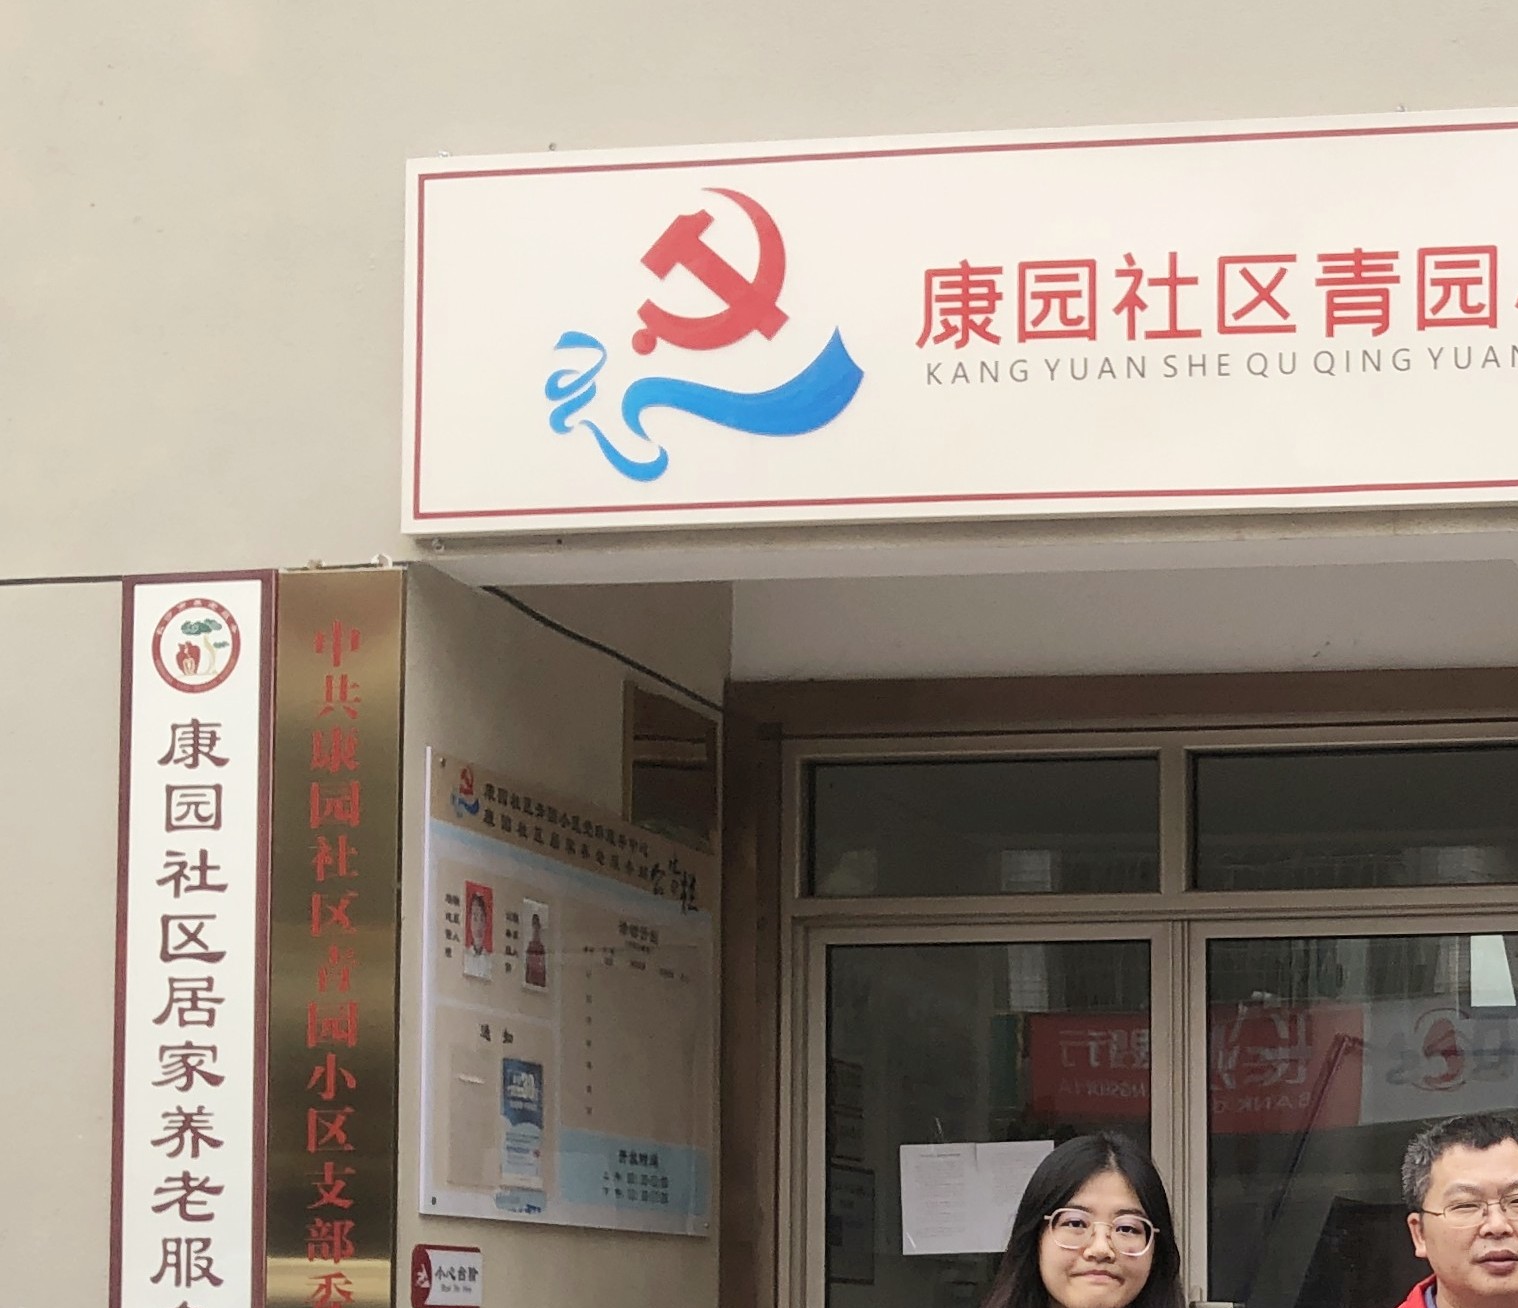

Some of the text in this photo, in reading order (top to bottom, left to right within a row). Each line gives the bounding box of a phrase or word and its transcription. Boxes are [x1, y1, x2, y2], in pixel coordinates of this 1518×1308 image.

[928, 360, 1027, 384] KANG
[1045, 356, 1145, 380] YUAN
[1164, 354, 1229, 377] SHE
[1247, 353, 1296, 379] QU
[1313, 349, 1411, 376] QING
[434, 1265, 479, 1283] 小心台阶
